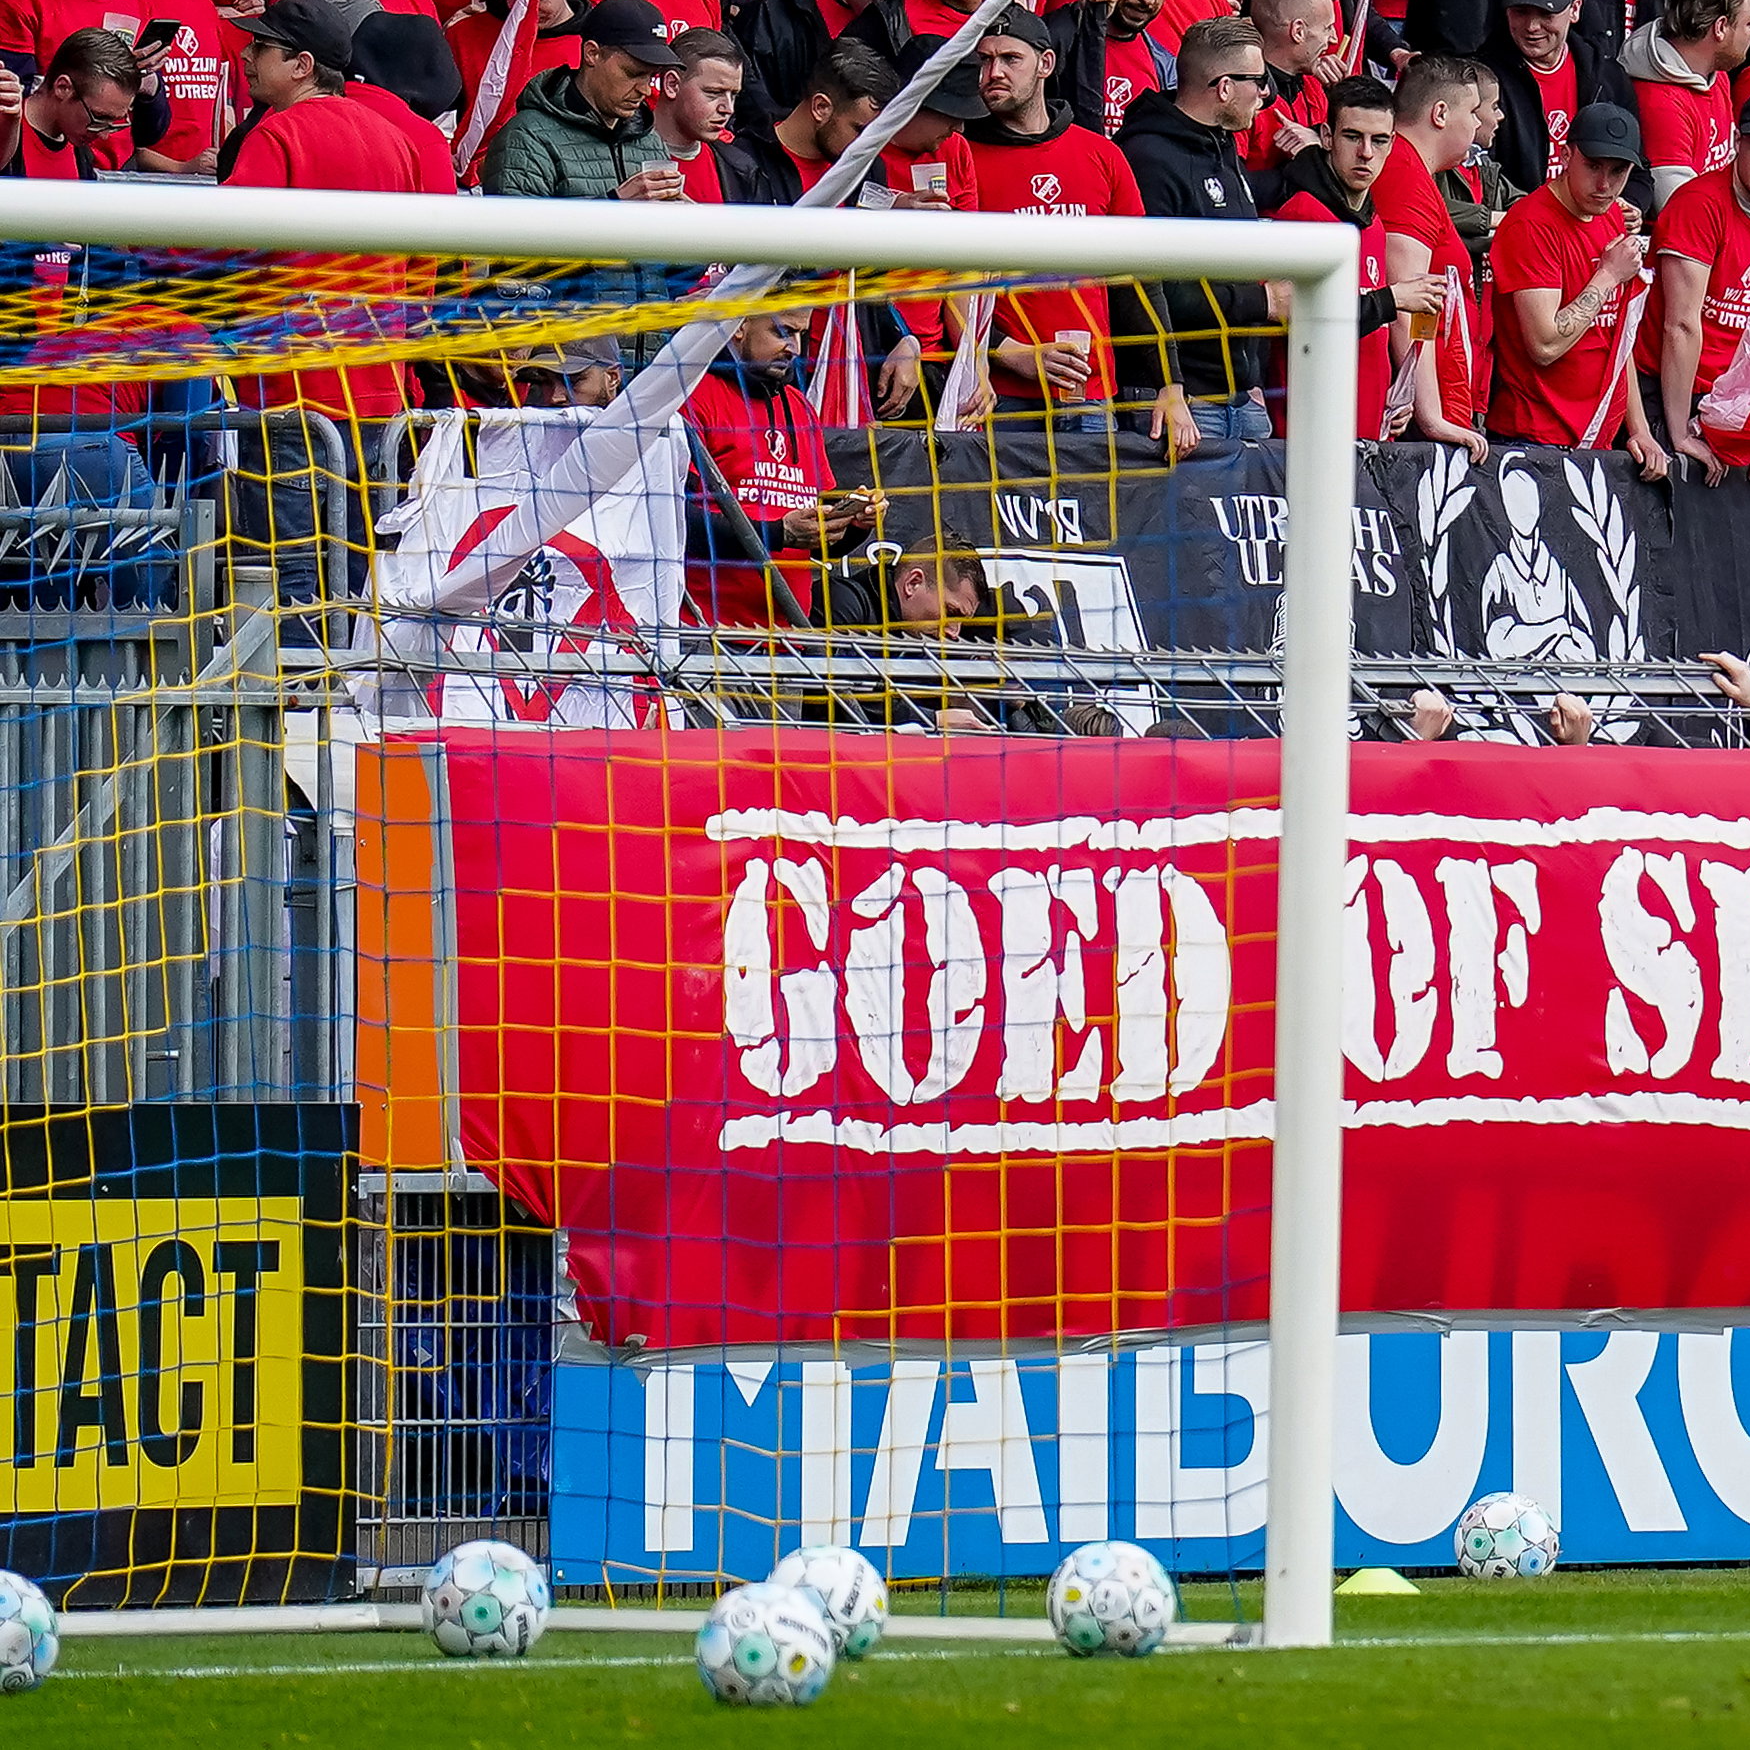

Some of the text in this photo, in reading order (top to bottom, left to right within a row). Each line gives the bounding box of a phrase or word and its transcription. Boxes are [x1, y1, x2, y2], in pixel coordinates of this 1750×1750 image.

[164, 58, 216, 73] WIJ ZIJN
[175, 84, 218, 98] UTREC
[755, 462, 803, 483] WIJ ZIJN
[738, 487, 819, 512] FC UTRECHT
[1210, 493, 1402, 556] UTRHT
[1238, 539, 1398, 596] ULAS
[723, 857, 1230, 1106] GOED
[1342, 854, 1541, 1084] OF
[0, 1239, 280, 1469] TACT
